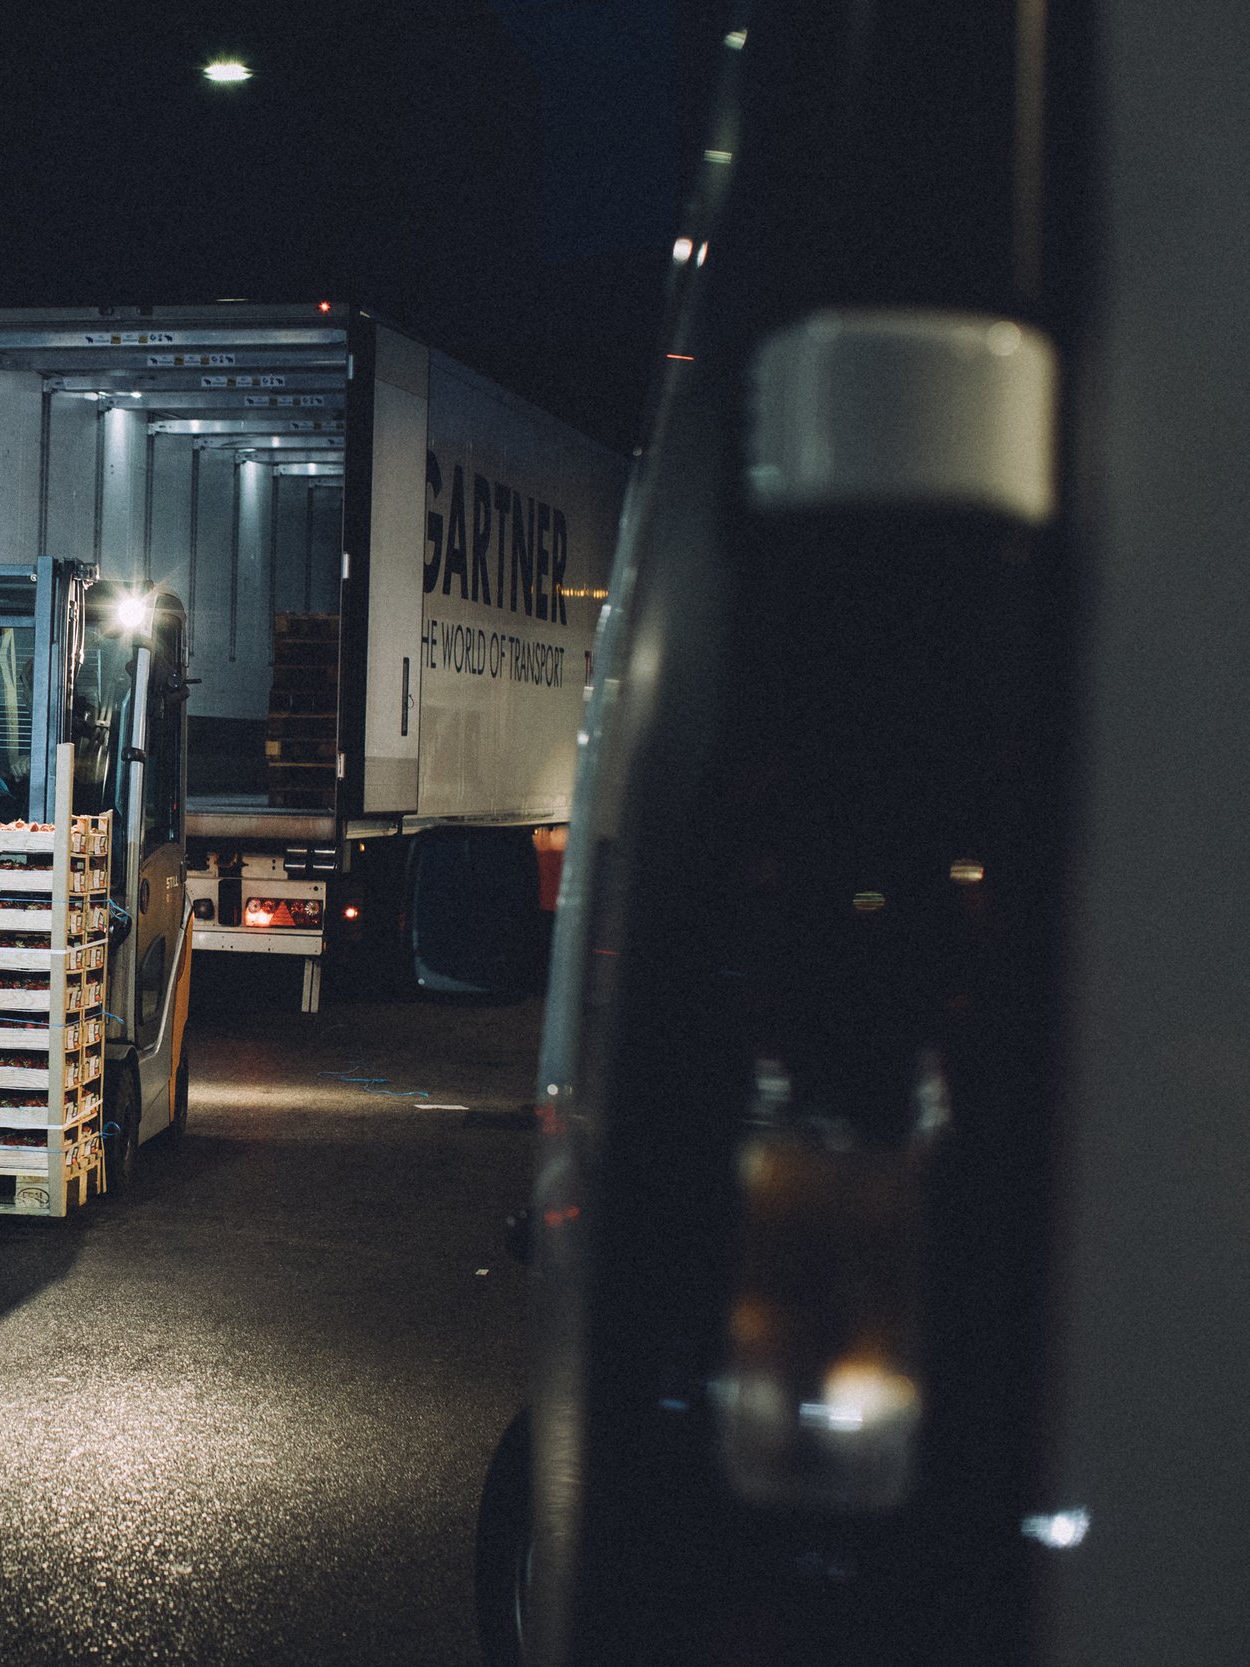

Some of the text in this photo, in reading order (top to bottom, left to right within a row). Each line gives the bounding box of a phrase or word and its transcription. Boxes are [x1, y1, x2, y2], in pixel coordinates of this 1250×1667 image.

[423, 450, 568, 626] GARTNER
[441, 622, 486, 676] WORLD
[489, 632, 506, 678] OF
[508, 636, 565, 689] TRANSPORT
